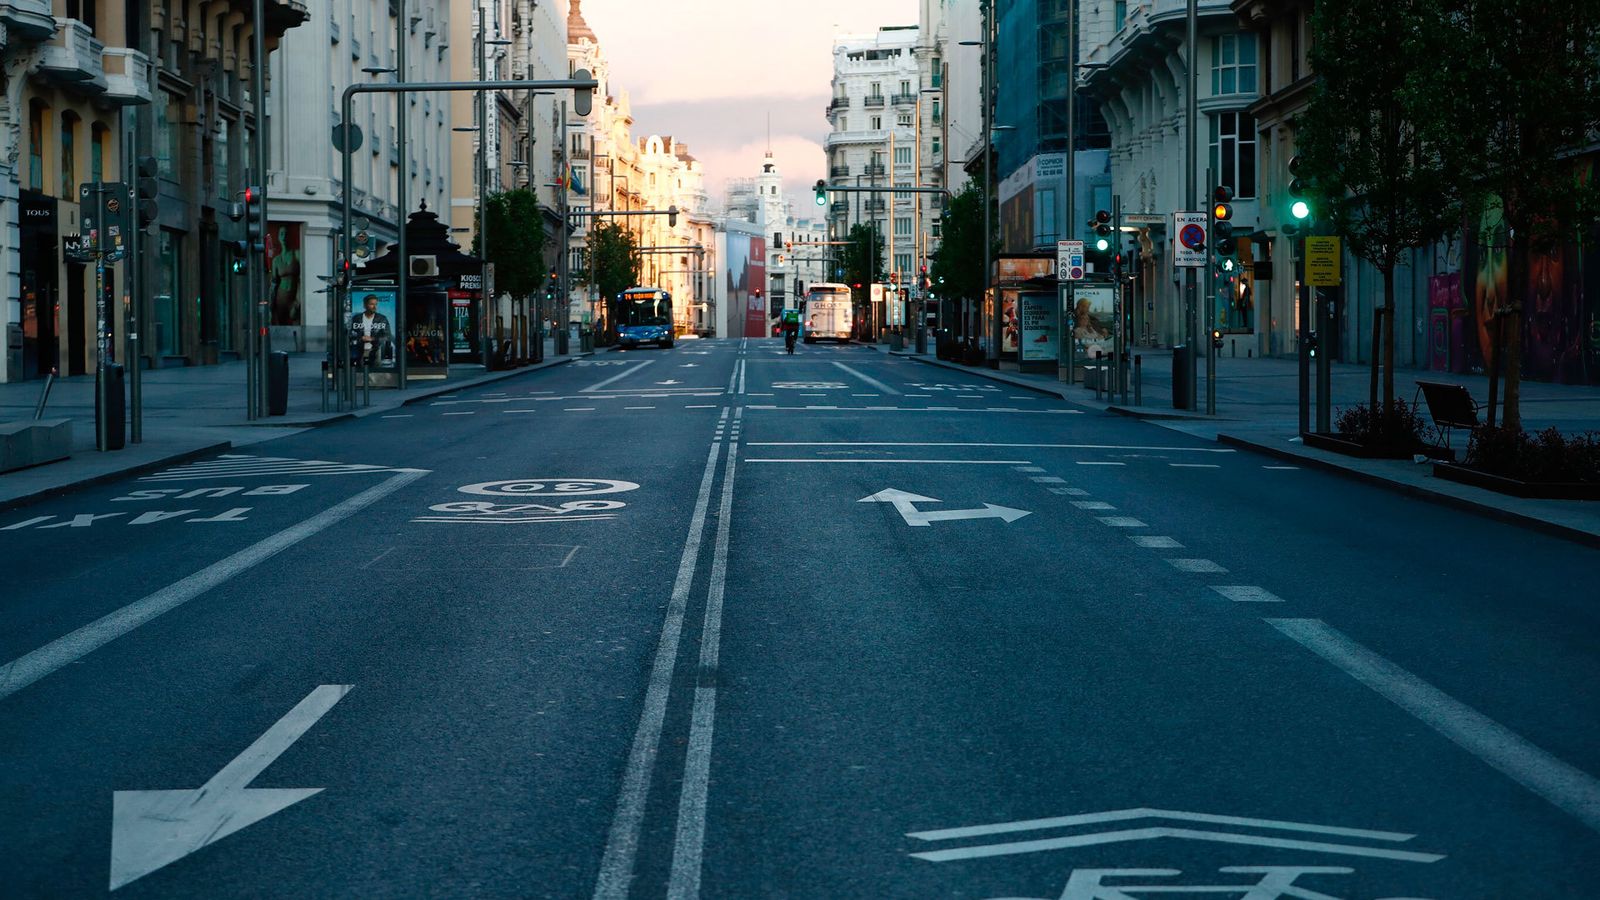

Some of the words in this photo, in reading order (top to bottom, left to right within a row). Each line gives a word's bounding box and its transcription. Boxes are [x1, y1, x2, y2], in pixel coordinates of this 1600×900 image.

[25, 209, 50, 217] TOUS
[460, 274, 482, 282] KIOSC
[454, 306, 469, 320] TIZA
[352, 322, 387, 330] EXPORER
[109, 483, 312, 501] BUS
[500, 482, 597, 492] 30
[0, 507, 255, 531] TAXI
